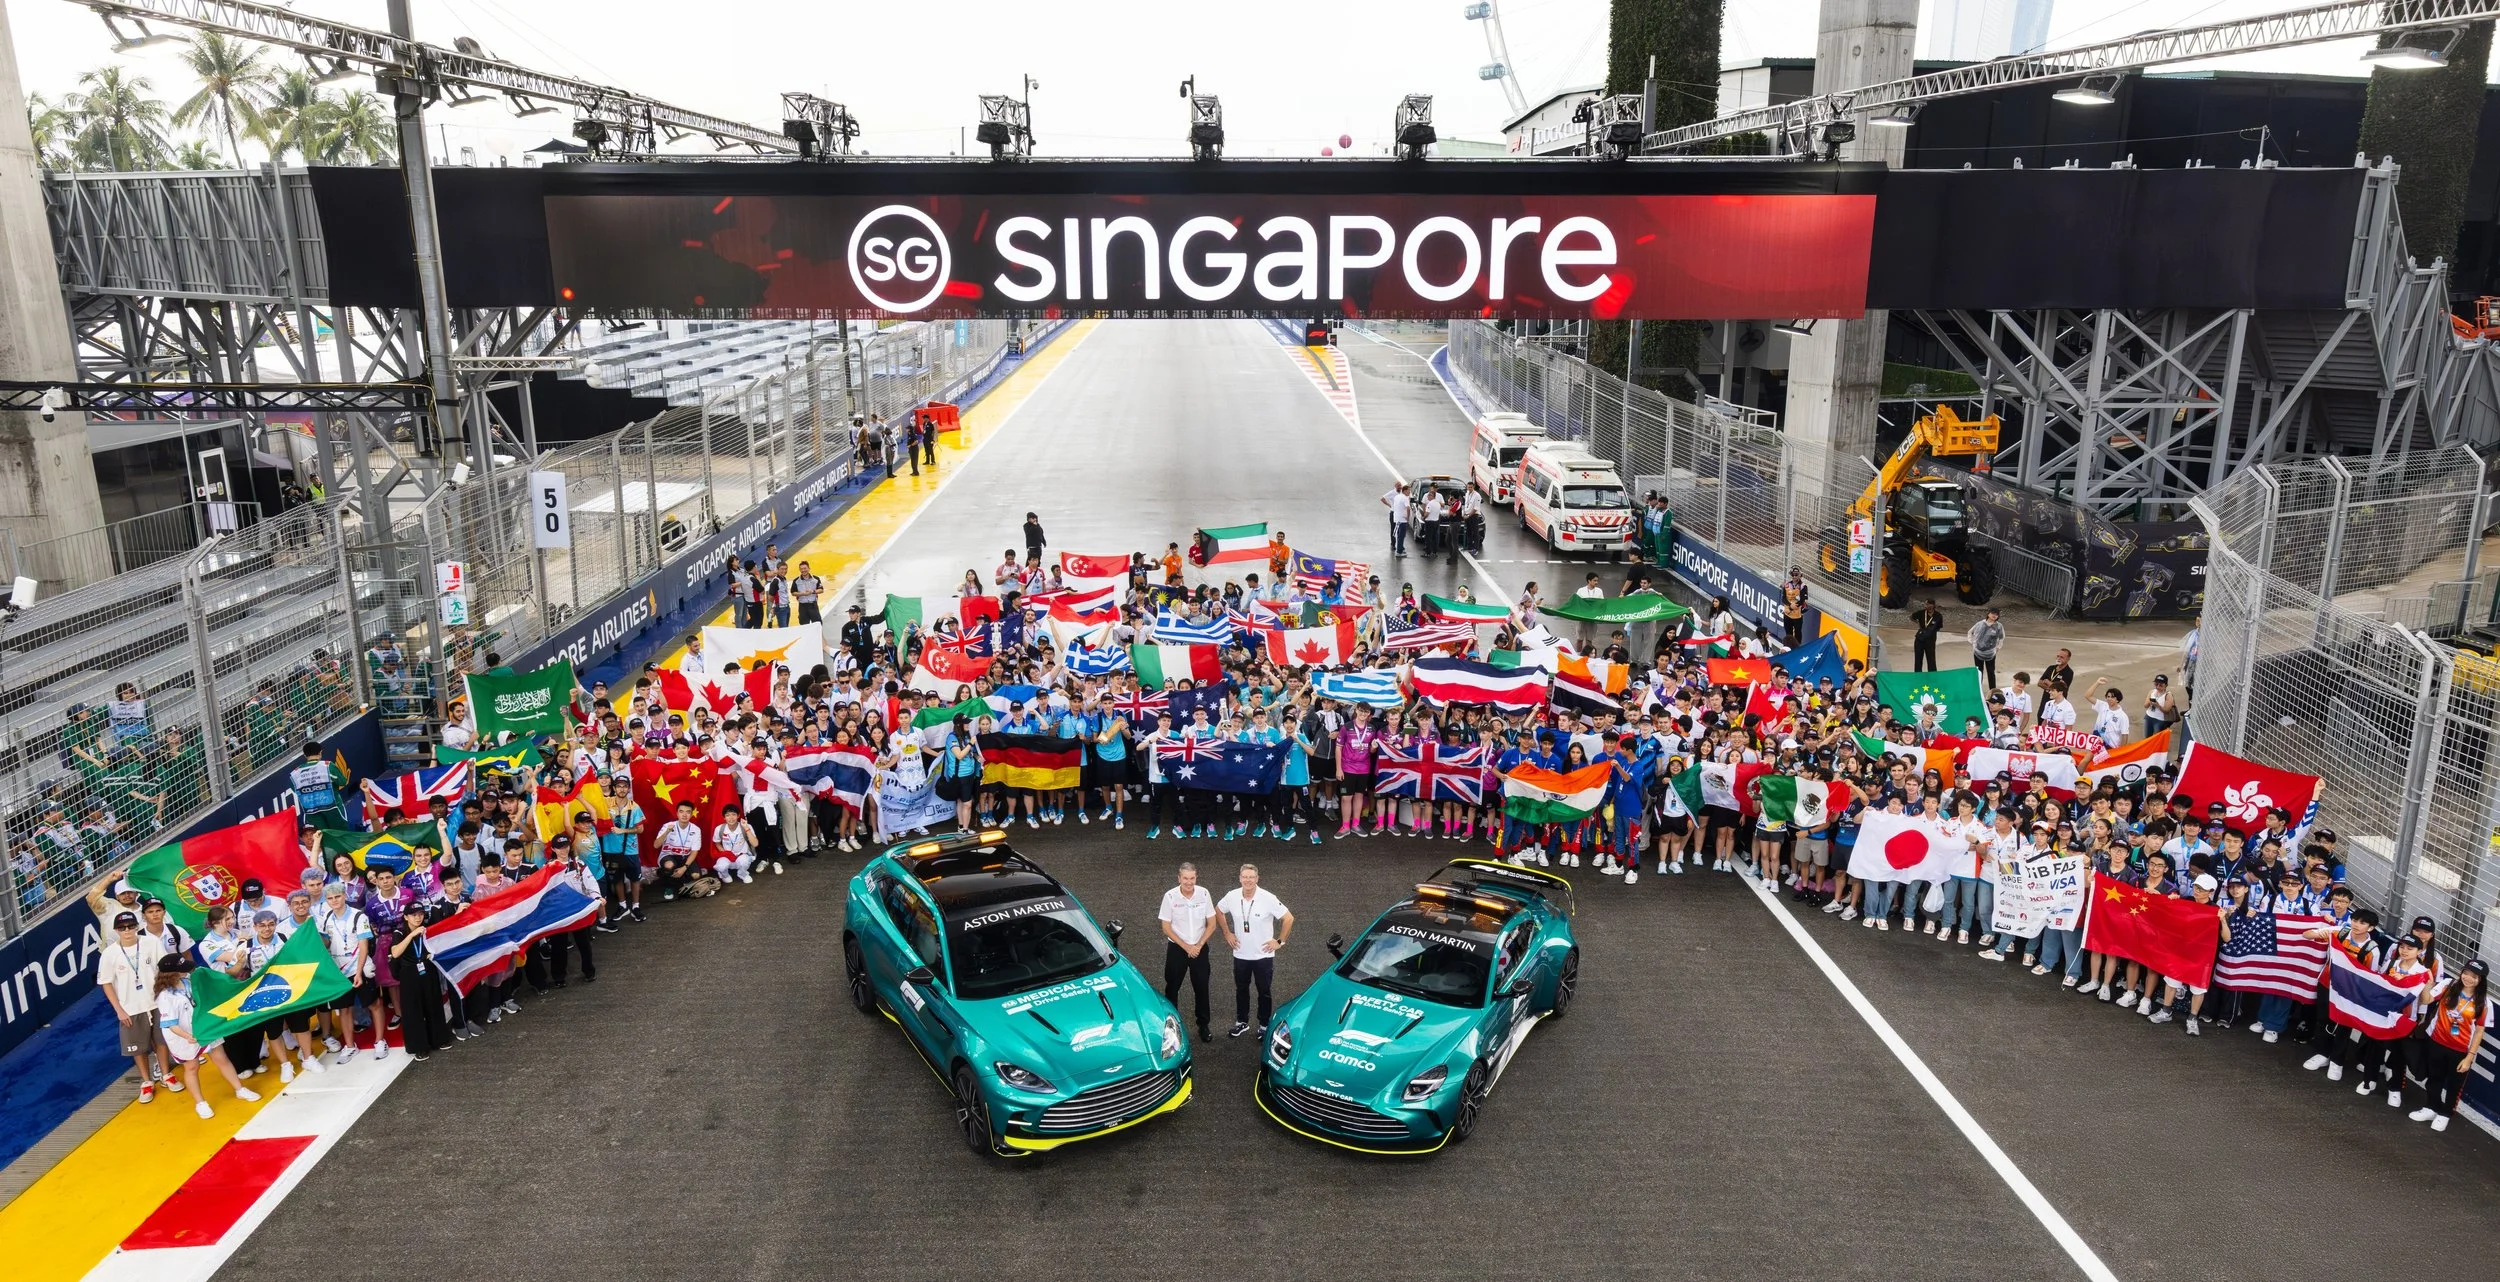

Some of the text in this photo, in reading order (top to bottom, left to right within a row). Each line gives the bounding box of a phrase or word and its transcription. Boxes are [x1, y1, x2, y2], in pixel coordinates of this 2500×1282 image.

[864, 237, 937, 282] SG
[1897, 433, 1916, 461] JCB
[793, 462, 848, 513] SINGAPORE AIRLINES
[544, 488, 560, 533] 50
[686, 513, 772, 588] SINGAPORE AIRLINES
[1672, 542, 1785, 627] SINGAPORE AIRLINES
[591, 596, 648, 655] AIRLINES
[2050, 875, 2077, 890] VISA
[964, 901, 1065, 931] ASTON MARTIN
[1387, 925, 1476, 952] ASTON MARTIN
[1017, 983, 1081, 1004] MEDICAL
[1083, 976, 1112, 986] CAR
[1033, 995, 1060, 1006] Drive
[1352, 994, 1425, 1017] SAFETY CAR
[1319, 1050, 1376, 1071] aramco
[1316, 1087, 1340, 1098] SAFETY
[1340, 1094, 1354, 1102] CAR
